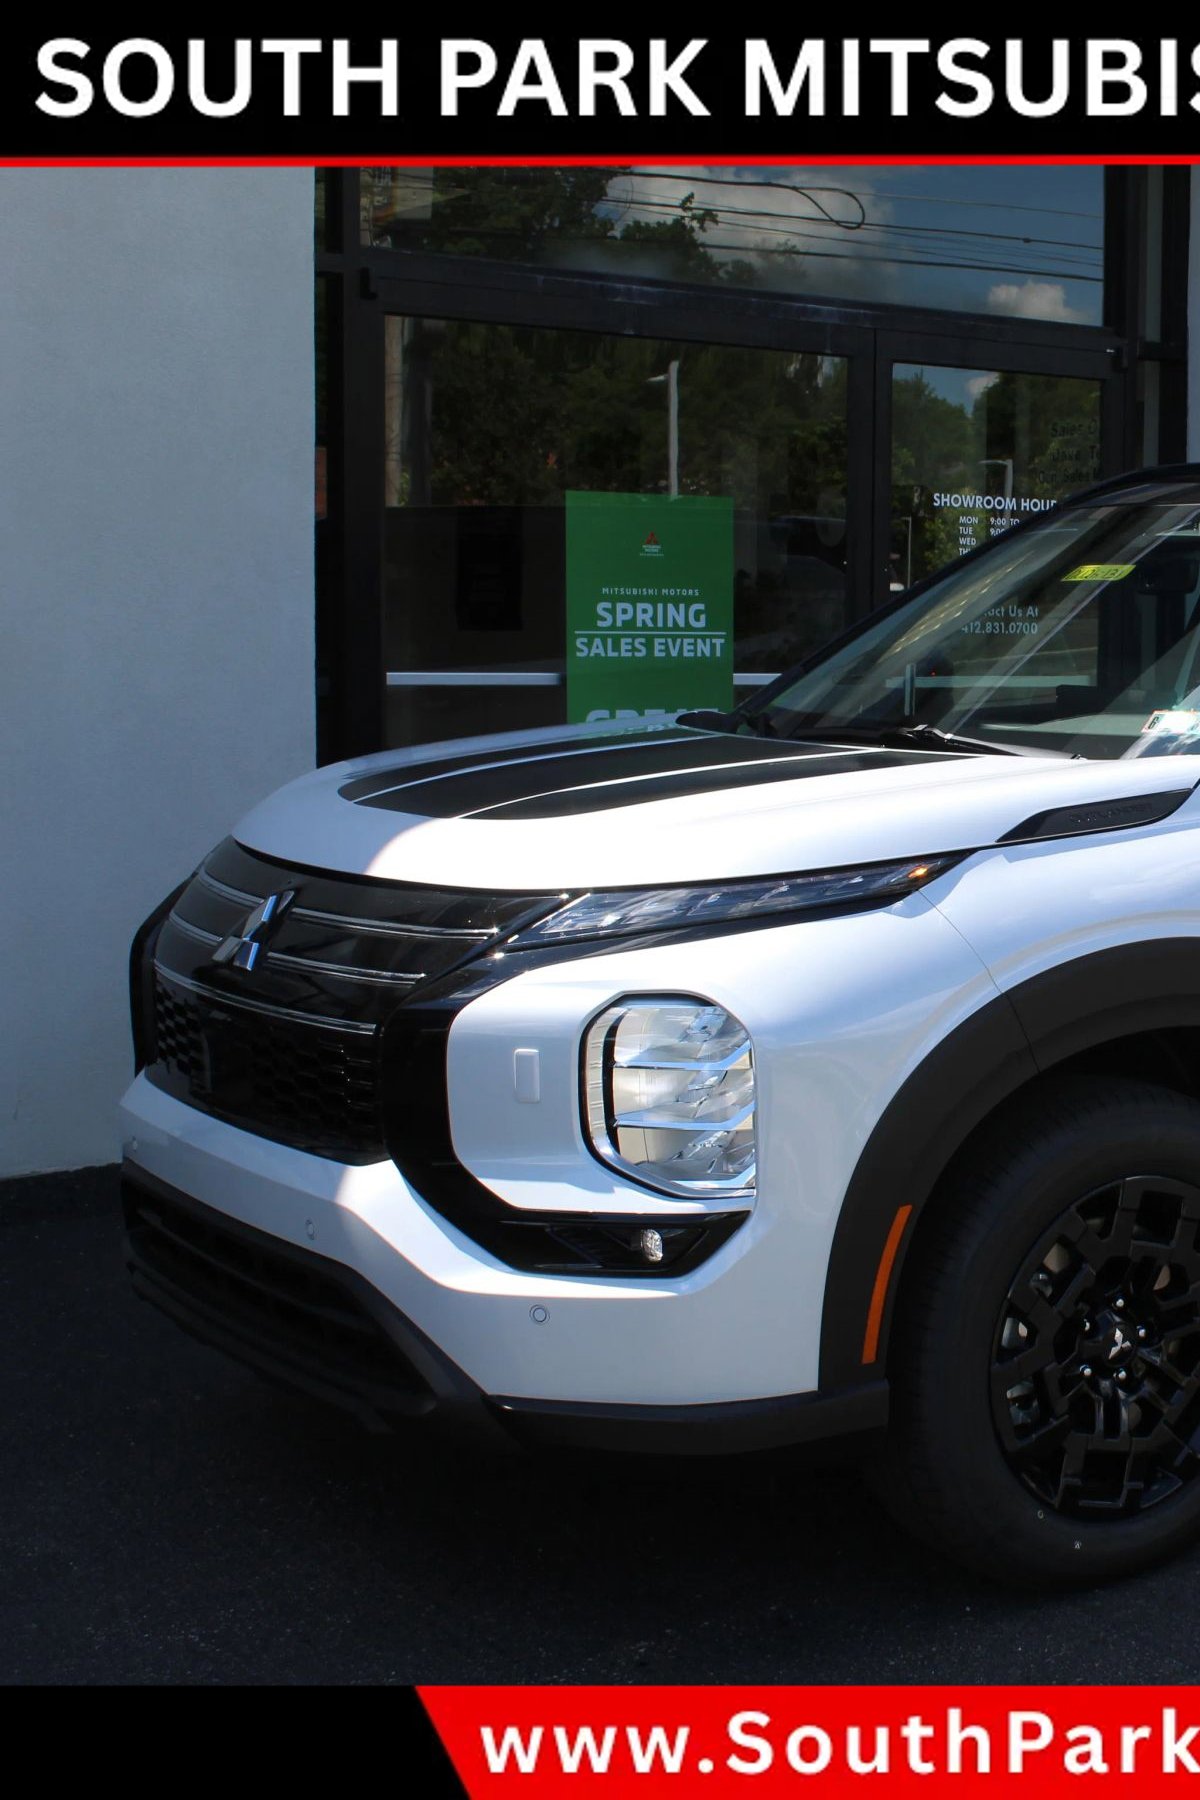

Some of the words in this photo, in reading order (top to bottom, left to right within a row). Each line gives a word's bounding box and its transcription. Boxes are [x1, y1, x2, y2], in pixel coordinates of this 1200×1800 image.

[932, 492, 1018, 511] SHOWROOM
[959, 515, 979, 525] MON
[989, 517, 1007, 526] 9:00
[959, 526, 973, 535] TUE
[958, 537, 977, 546] WED
[602, 587, 658, 596] MITSUBISHI
[661, 588, 700, 597] MOTORS
[596, 601, 706, 629] SPRING
[575, 637, 647, 658] SALES
[653, 637, 726, 658] EVENT
